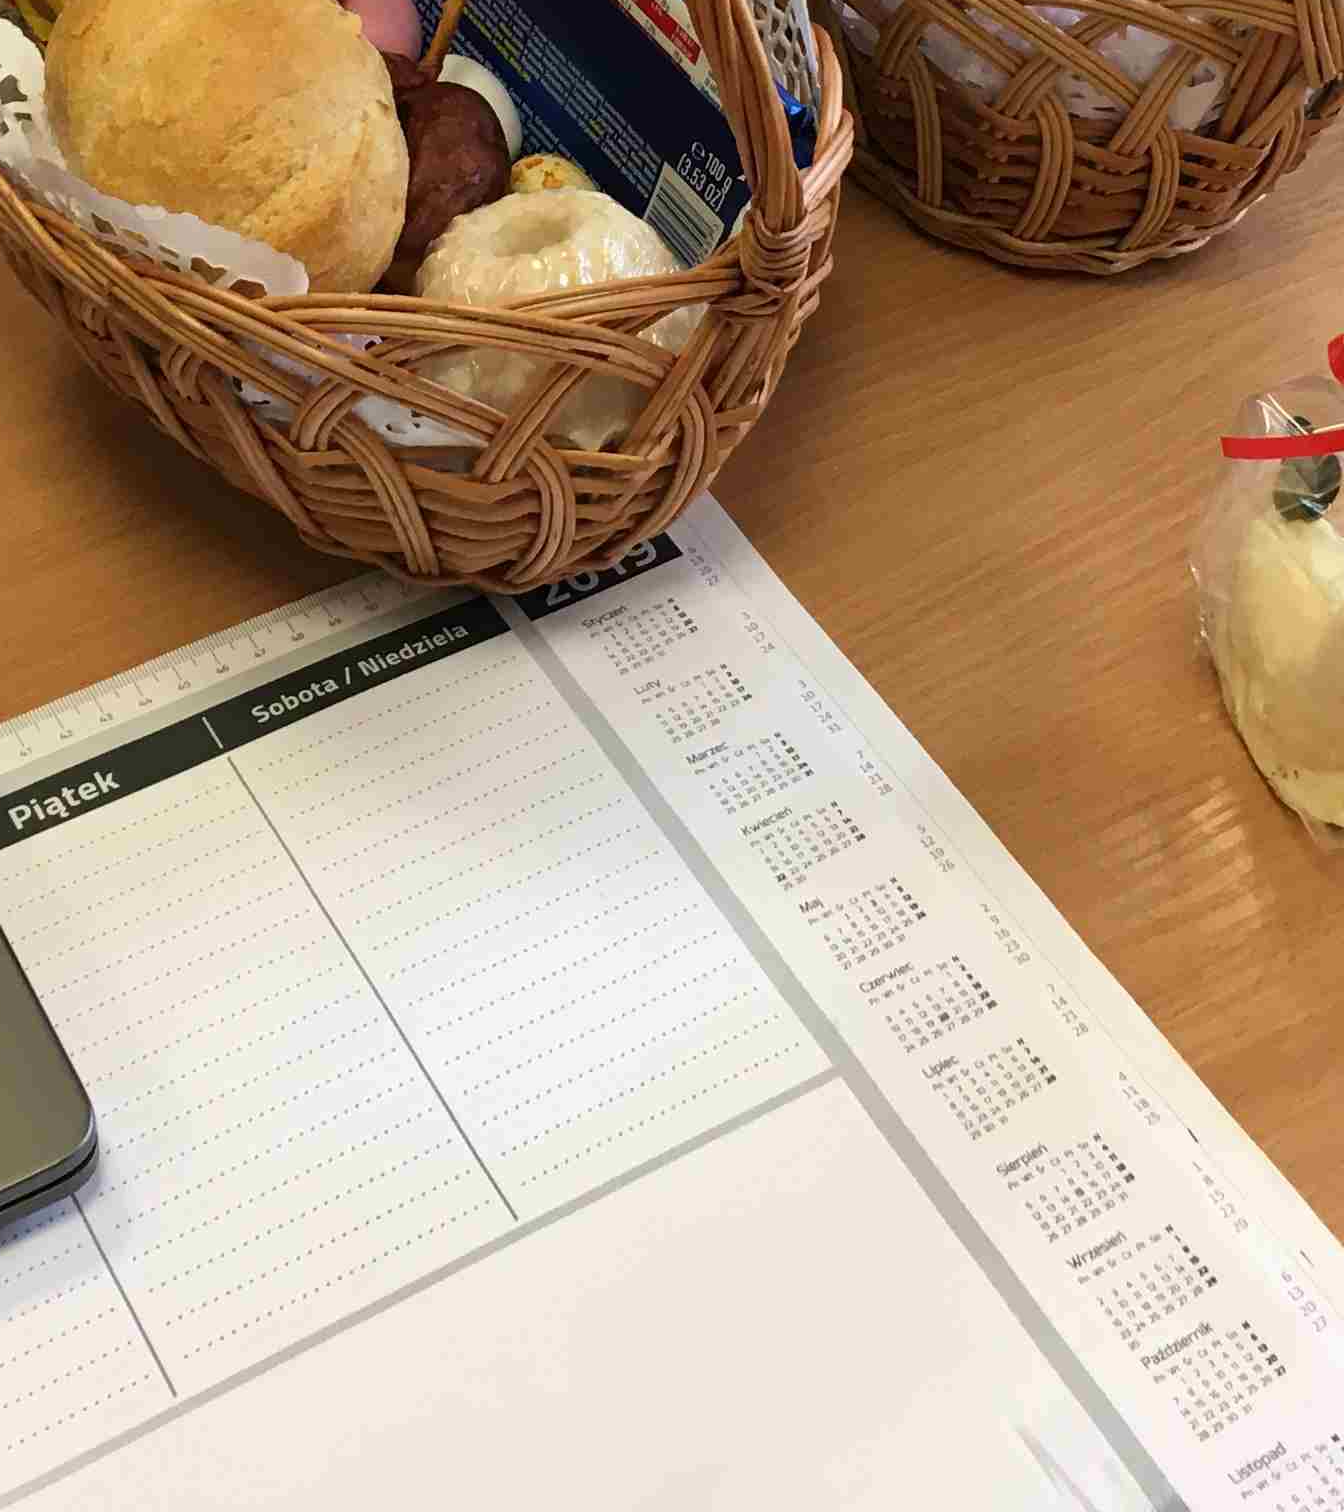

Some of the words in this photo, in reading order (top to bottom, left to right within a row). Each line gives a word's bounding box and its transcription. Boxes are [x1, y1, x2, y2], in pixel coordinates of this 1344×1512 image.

[705, 153, 725, 182] 100
[723, 178, 732, 194] g
[250, 674, 340, 725] Sobota
[343, 663, 352, 686] /
[357, 621, 469, 678] Niedziela
[633, 679, 662, 696] Luty
[686, 742, 729, 765] Marzec
[7, 768, 122, 832] Piątek
[858, 962, 915, 994] Czerwiec
[922, 1055, 959, 1079] Lipiec
[995, 1143, 1048, 1177] Sierpień
[1227, 1441, 1287, 1485] Listopad
